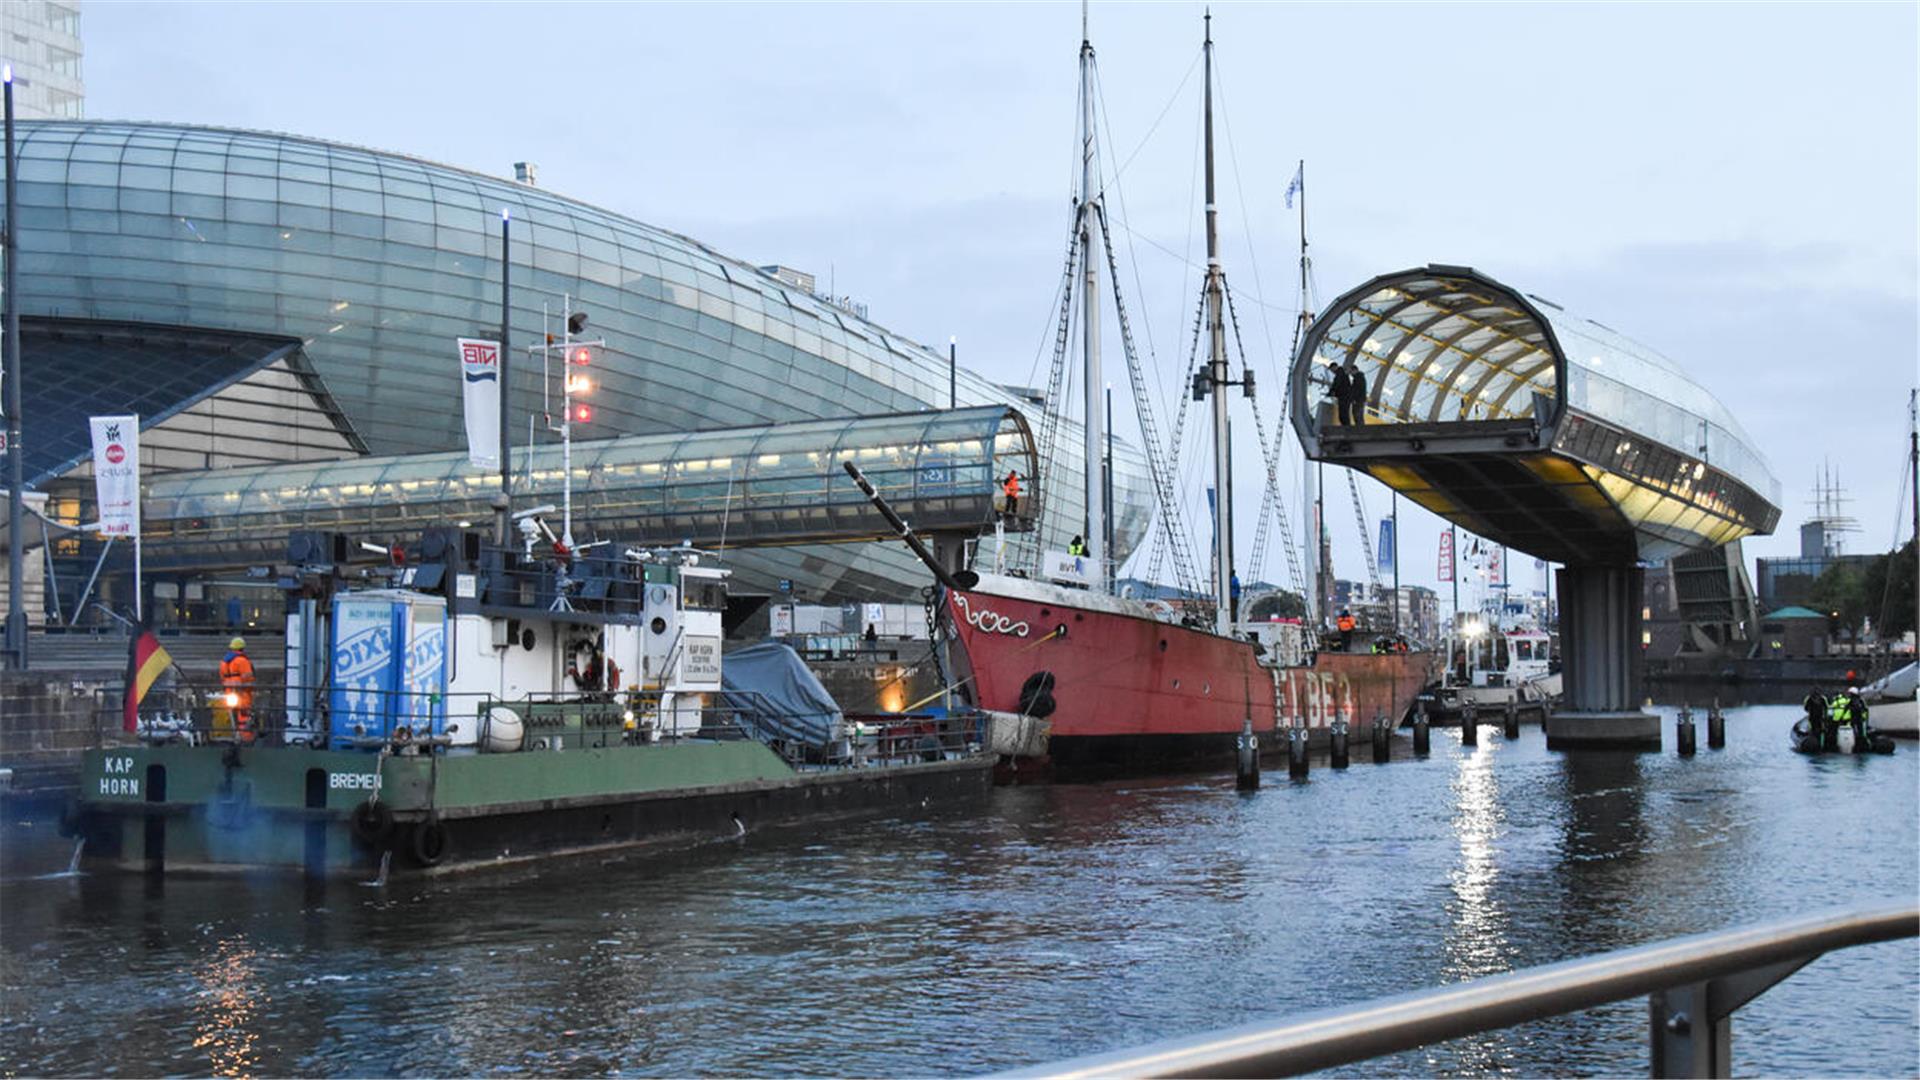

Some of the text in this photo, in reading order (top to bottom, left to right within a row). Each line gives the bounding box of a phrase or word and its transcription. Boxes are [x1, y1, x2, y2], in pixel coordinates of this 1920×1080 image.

[105, 757, 133, 773] KAP
[100, 778, 138, 795] HORN
[330, 773, 382, 789] BREMEN
